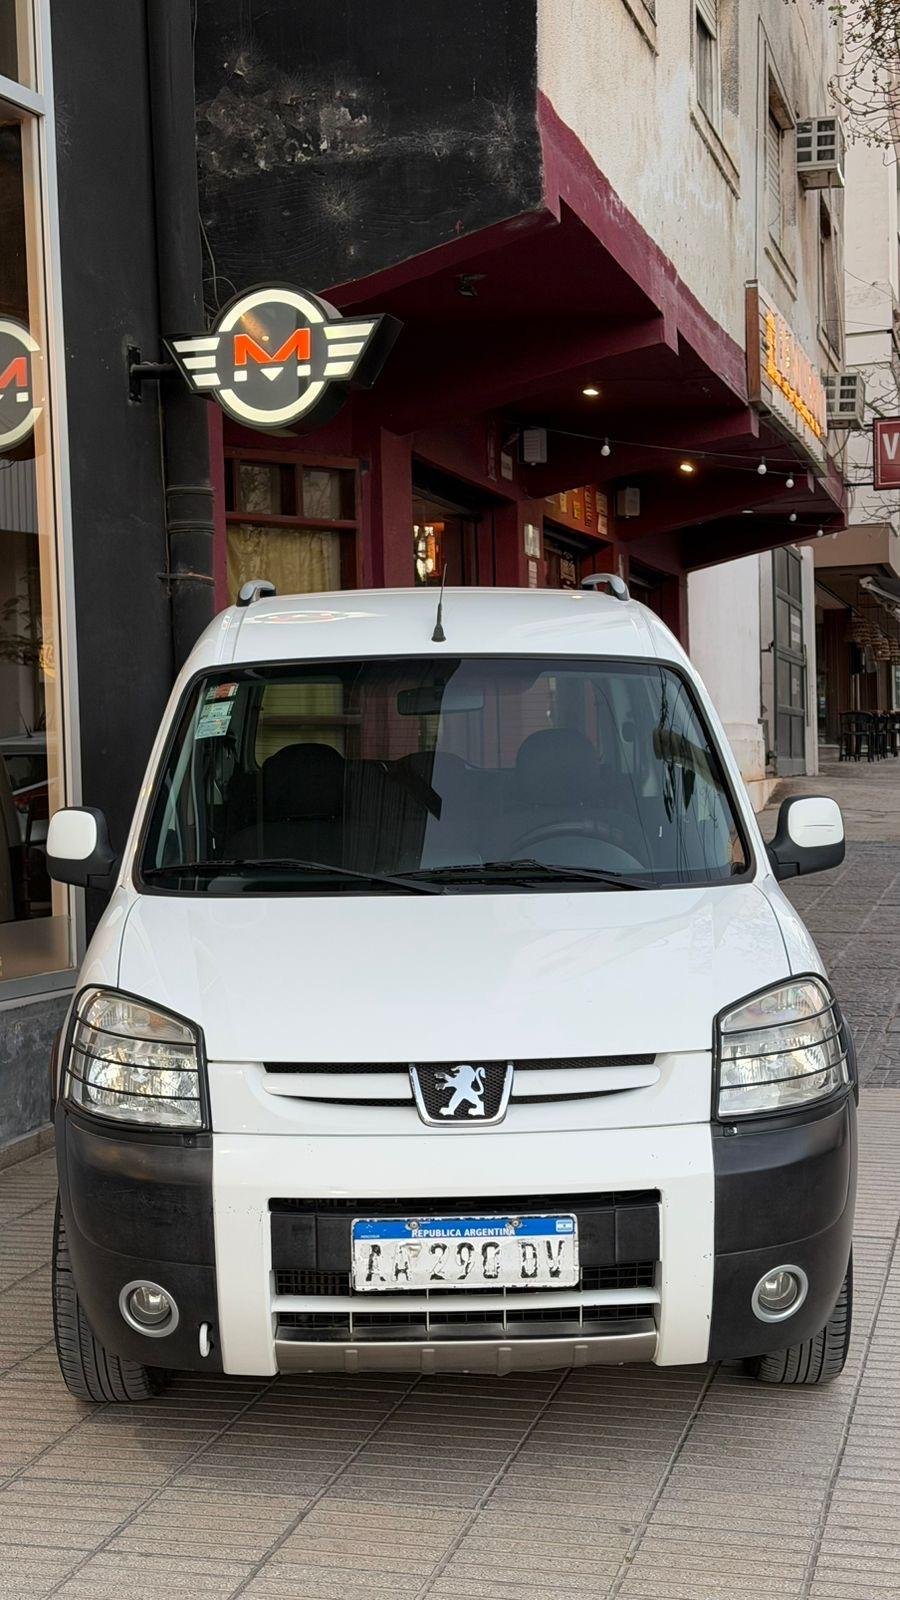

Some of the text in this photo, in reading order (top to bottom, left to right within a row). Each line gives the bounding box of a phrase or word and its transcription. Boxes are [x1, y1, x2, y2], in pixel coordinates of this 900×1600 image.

[234, 328, 311, 369] M
[882, 432, 900, 460] V
[464, 1227, 516, 1237] ARGENTINA
[519, 1240, 566, 1279] DV
